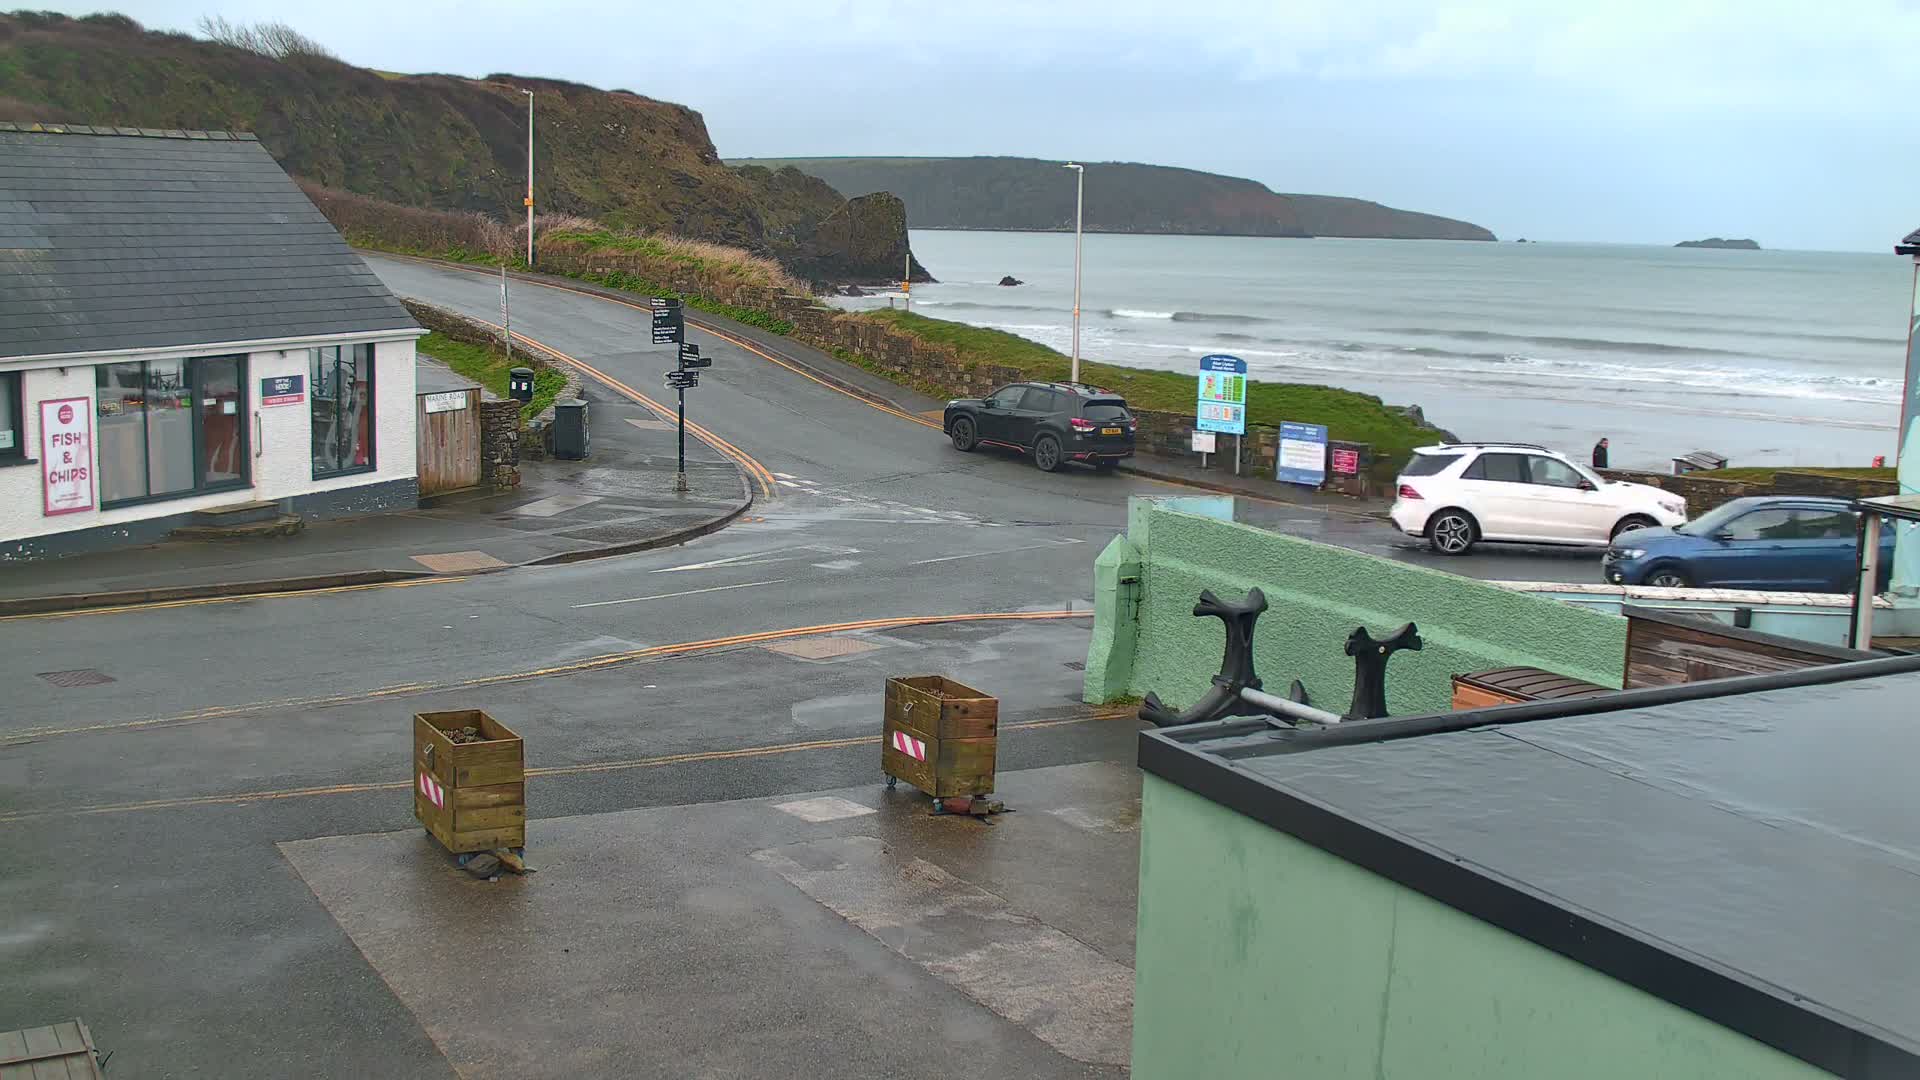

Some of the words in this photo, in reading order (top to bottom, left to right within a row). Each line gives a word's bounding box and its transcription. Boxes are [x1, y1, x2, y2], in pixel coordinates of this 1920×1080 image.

[426, 393, 448, 401] MARINE
[449, 392, 465, 400] ROAD
[52, 432, 81, 449] FISH
[63, 451, 73, 464] &
[49, 467, 88, 485] CHIPS
